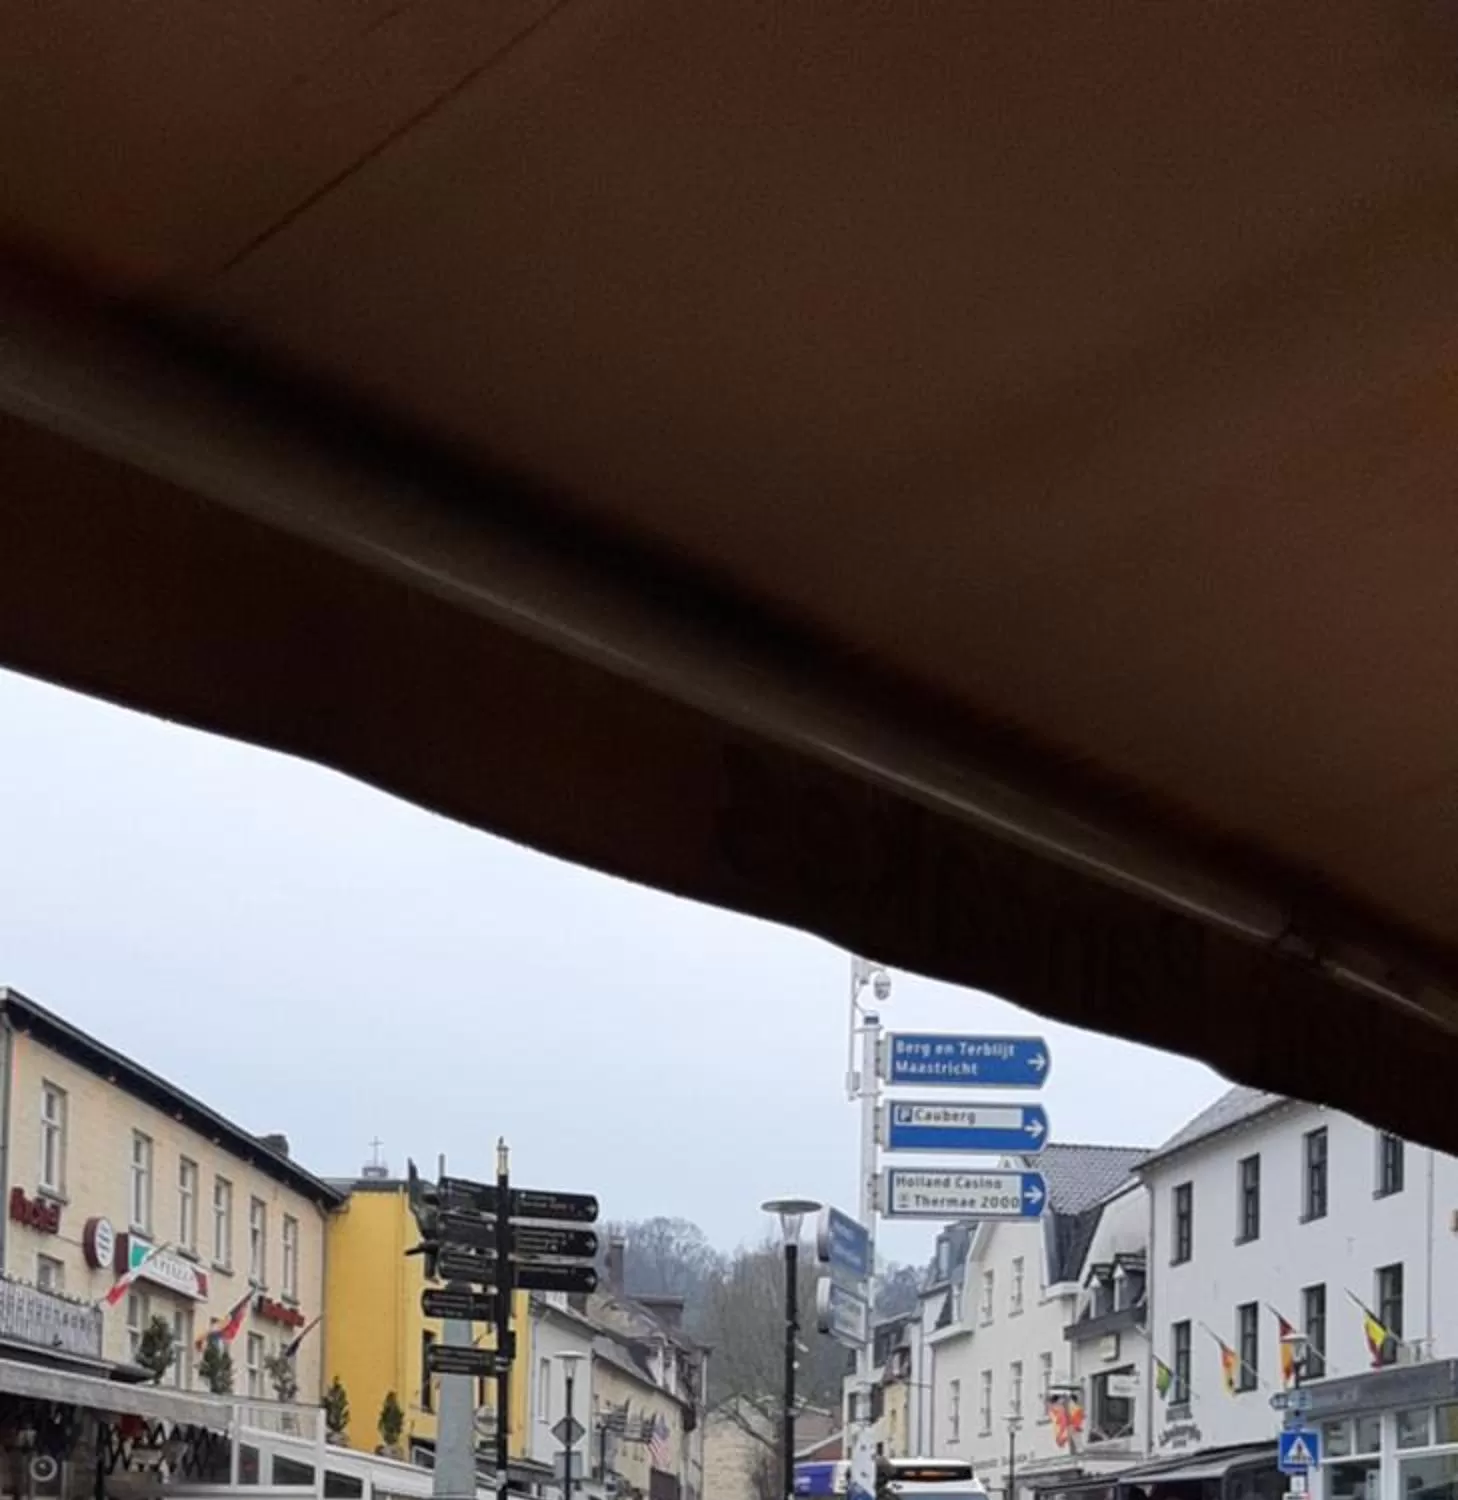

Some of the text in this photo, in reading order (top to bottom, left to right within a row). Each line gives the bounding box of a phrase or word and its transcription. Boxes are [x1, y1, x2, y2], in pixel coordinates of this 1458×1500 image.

[896, 1040, 1015, 1060] Berg en Terblijt
[895, 1060, 978, 1075] Maastricht
[915, 1107, 976, 1125] Cauberg
[895, 1175, 1003, 1190] Holland Casino
[914, 1194, 1020, 1209] Thermae 2000
